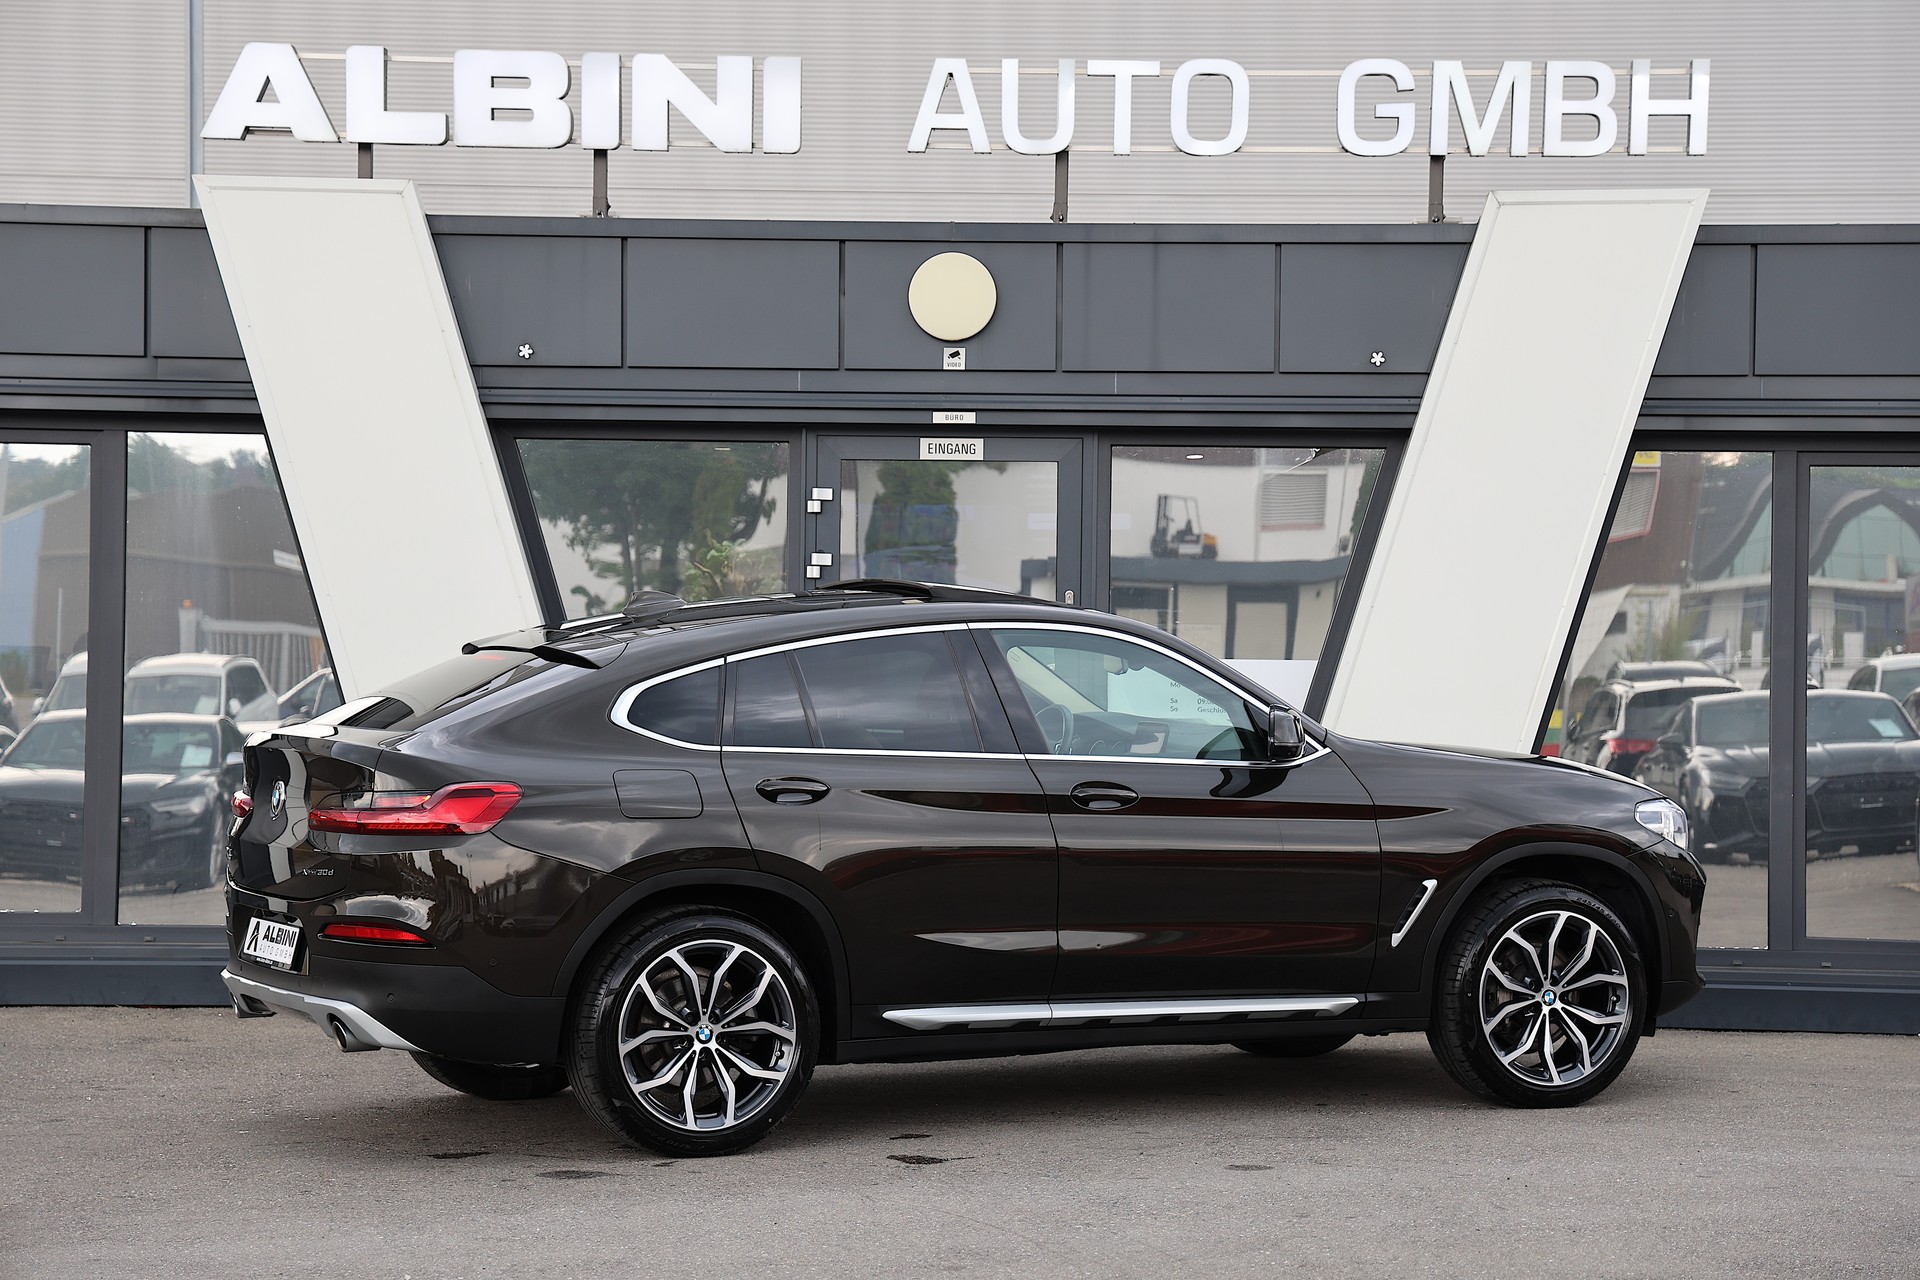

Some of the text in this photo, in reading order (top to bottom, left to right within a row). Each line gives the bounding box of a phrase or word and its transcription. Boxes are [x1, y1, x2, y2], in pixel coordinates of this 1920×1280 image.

[200, 41, 1711, 157] ALBINI AUTO GMBH
[944, 412, 964, 421] BÜRO
[927, 442, 977, 455] EINGANG
[262, 924, 298, 948] ALBINI
